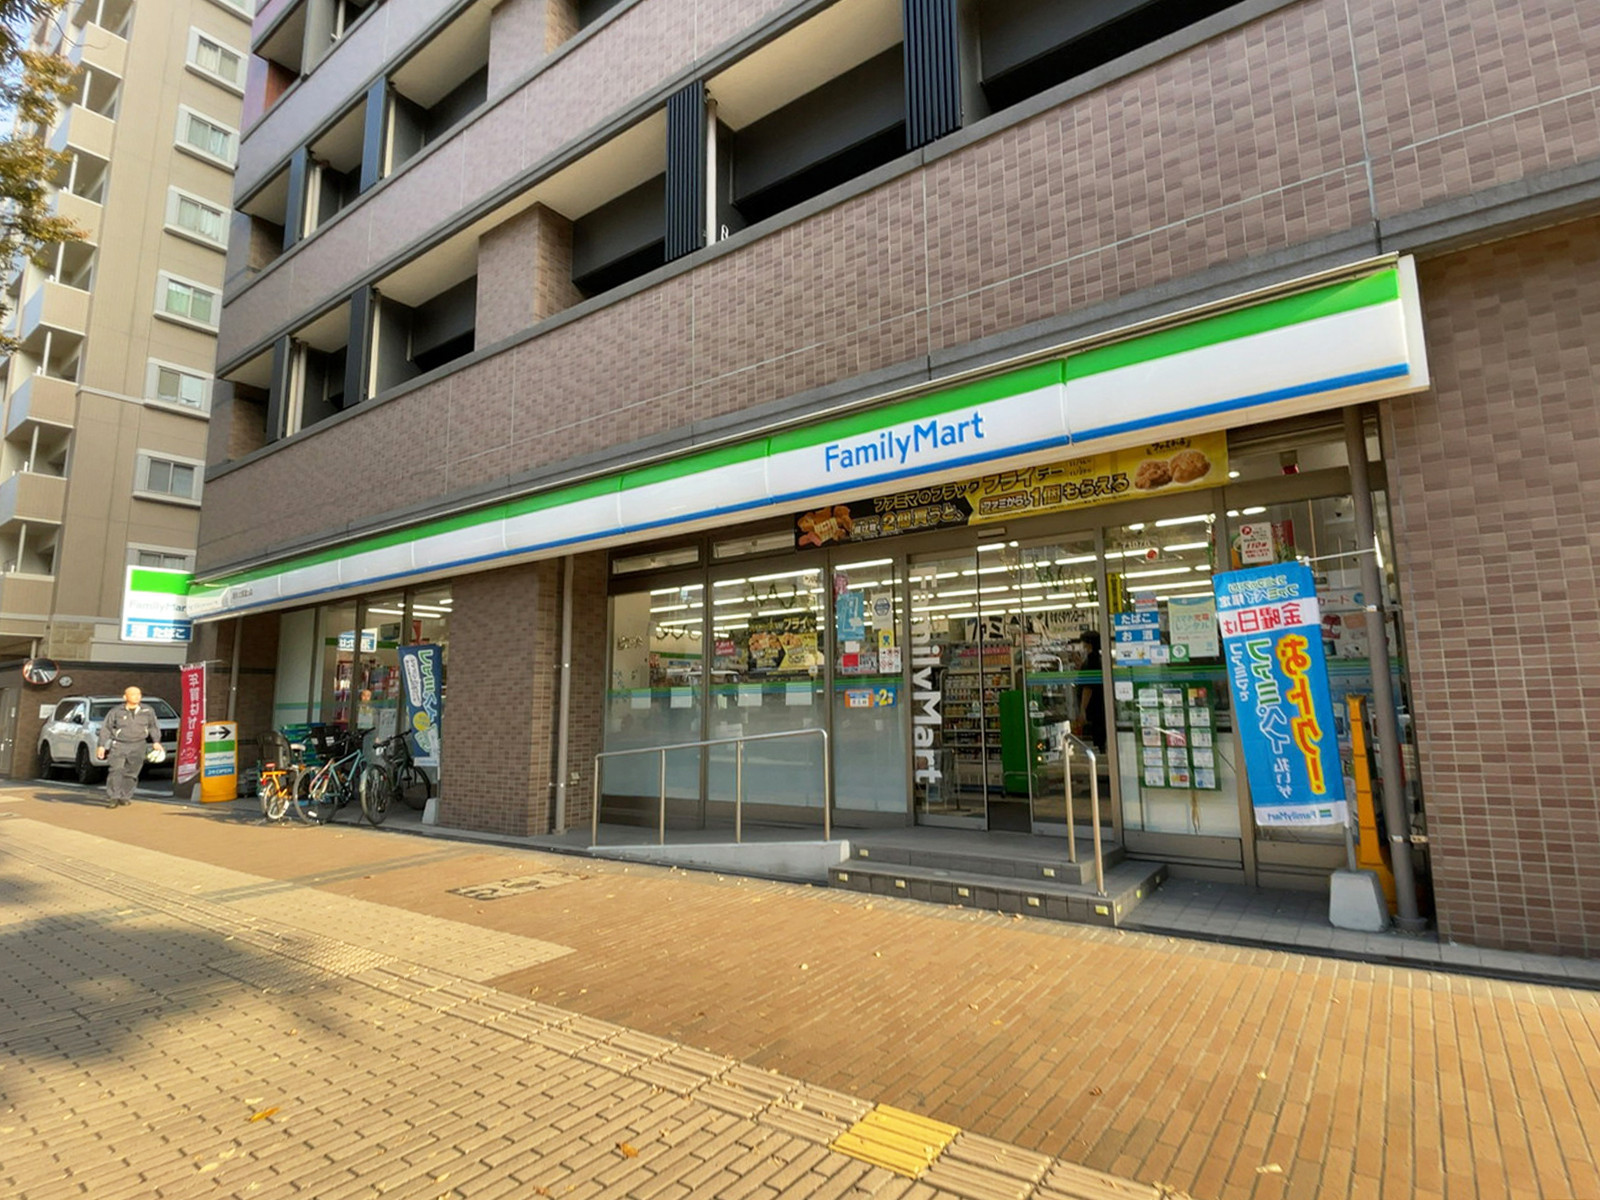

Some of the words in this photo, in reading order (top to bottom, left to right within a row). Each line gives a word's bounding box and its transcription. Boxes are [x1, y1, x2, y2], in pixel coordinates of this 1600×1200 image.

[825, 411, 984, 472] FamilyMart
[1121, 613, 1152, 625] たばこ
[909, 566, 942, 784] FamilyMart
